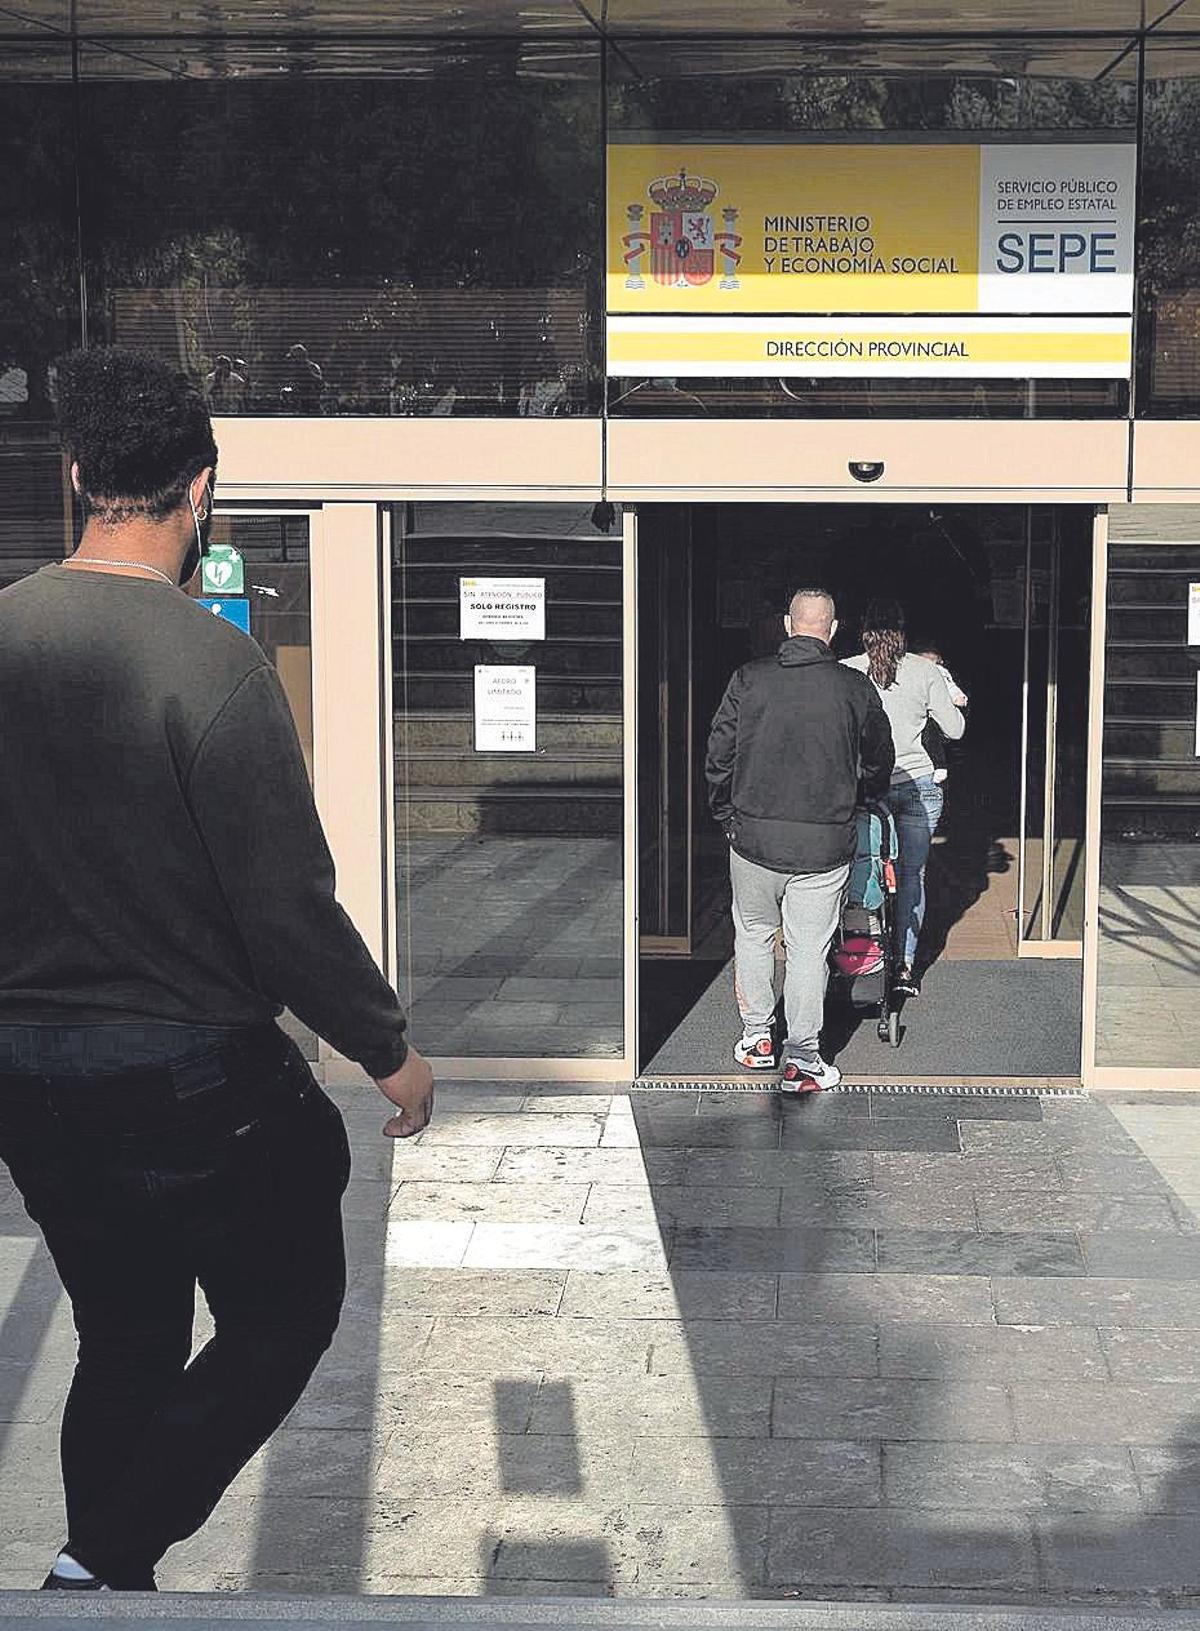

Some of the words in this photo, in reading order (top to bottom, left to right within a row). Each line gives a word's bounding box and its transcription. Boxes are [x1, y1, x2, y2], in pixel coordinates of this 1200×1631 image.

[997, 180, 1056, 194] SERVICIO
[1061, 178, 1118, 194] PÚBLICO
[997, 199, 1014, 210] DE
[1018, 199, 1064, 210] EMPLEO
[1069, 199, 1116, 210] ESTATAL
[765, 216, 869, 232] MINISTERIO
[765, 237, 788, 253] DE
[791, 237, 874, 255] TRABAJO
[997, 233, 1117, 273] SEPE
[764, 258, 776, 273] Y
[782, 255, 886, 273] ECONOMÍA
[891, 258, 959, 273] SOCIAL
[766, 339, 863, 357] DIRECCIÓN
[868, 341, 969, 357] PROVINCIAL
[470, 603, 493, 611] SOLO
[495, 603, 536, 611] REGISTRO
